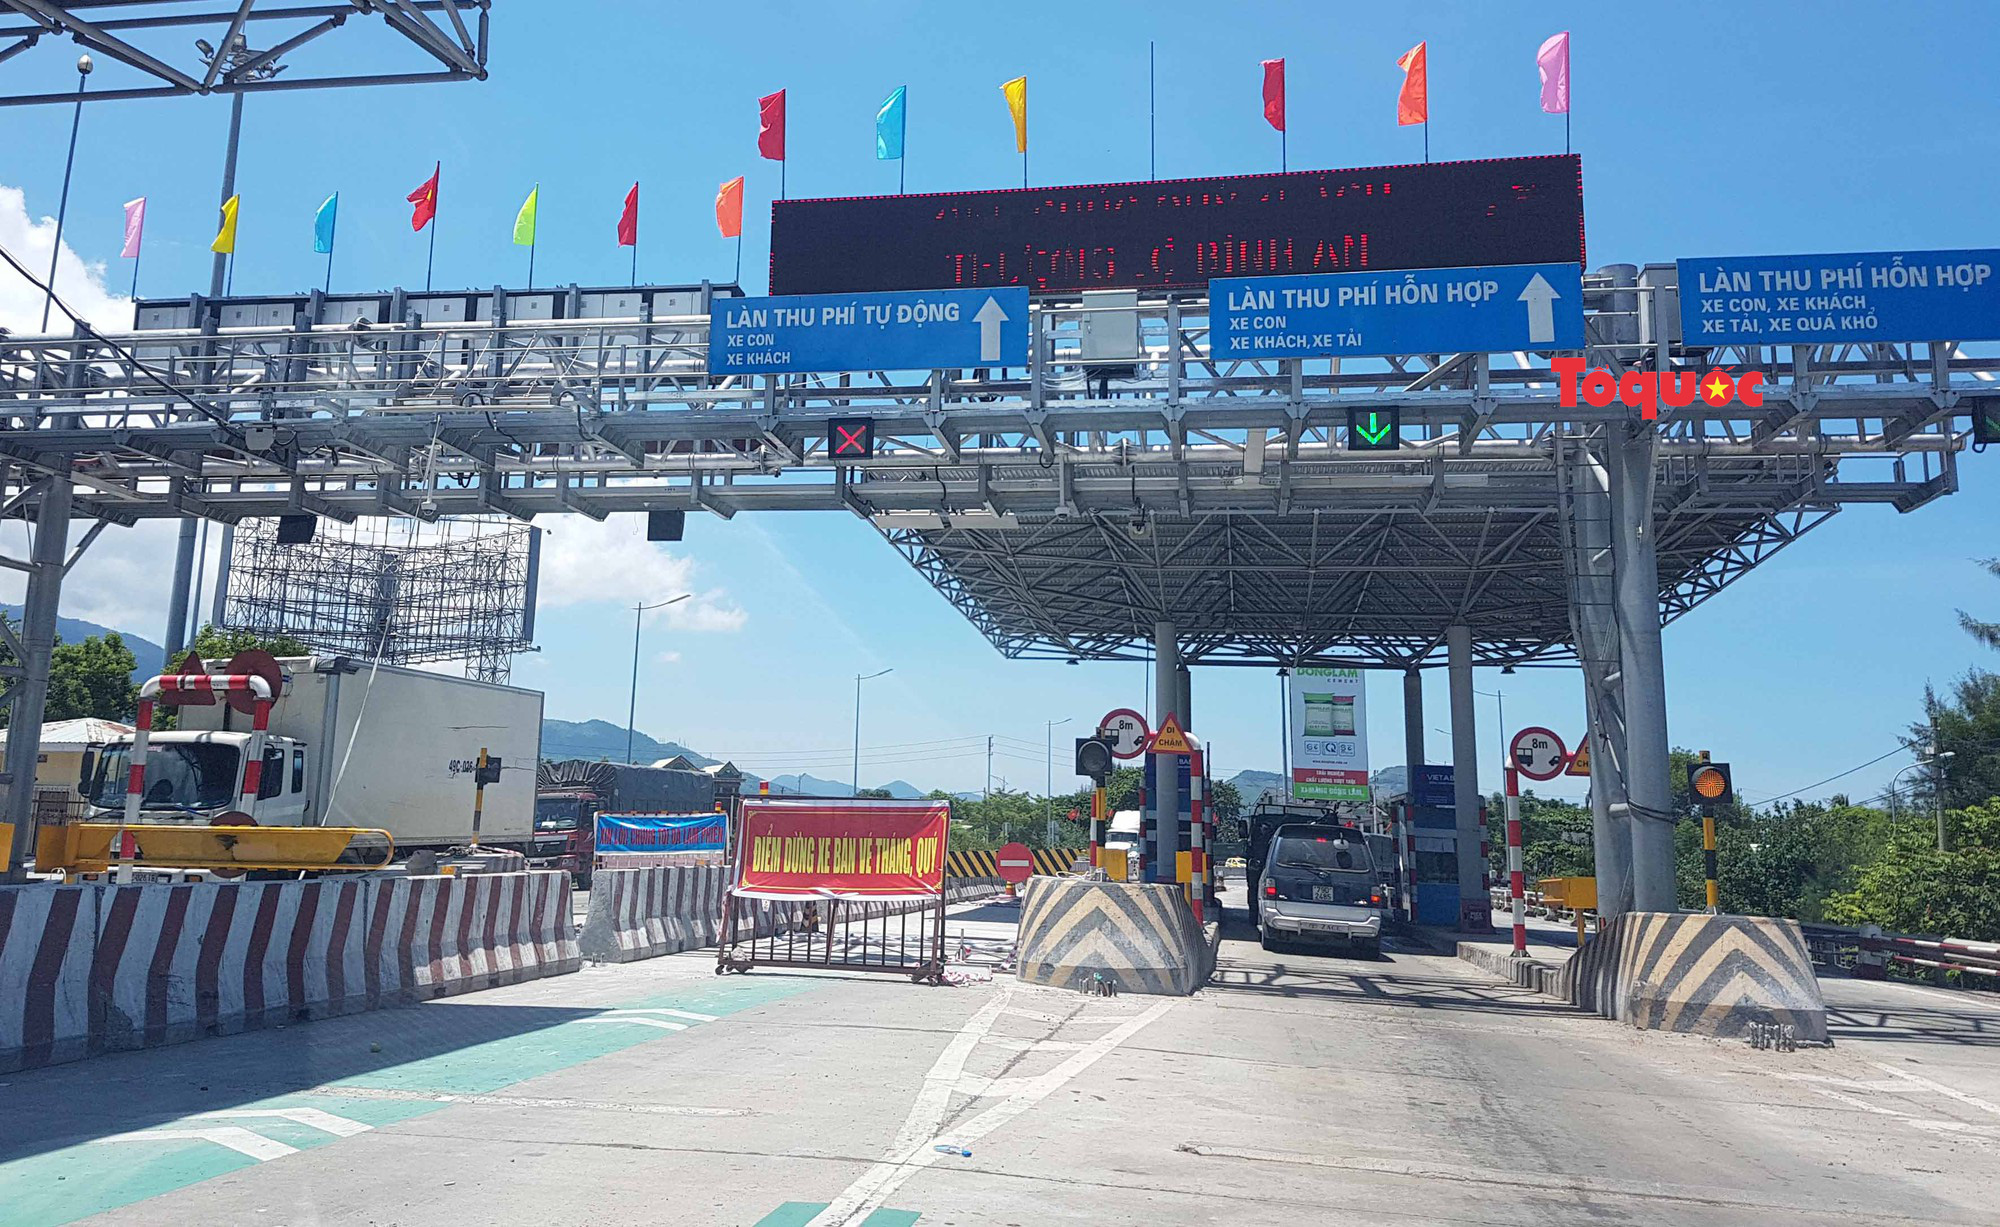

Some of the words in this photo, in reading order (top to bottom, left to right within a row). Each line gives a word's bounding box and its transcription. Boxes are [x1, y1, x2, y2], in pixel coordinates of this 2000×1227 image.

[1699, 266, 1750, 293] LÀN
[1759, 269, 1811, 292] THU
[1821, 262, 1863, 290] PHÍ
[1871, 256, 1928, 288] HỖN
[1937, 264, 1991, 292] HỢP
[1228, 286, 1275, 311] LÀN
[1282, 288, 1330, 309] THU
[1338, 280, 1378, 308] PHÍ
[1386, 274, 1438, 305] HỖN
[1447, 279, 1499, 308] HỢP
[1701, 299, 1724, 313] XE
[1729, 297, 1771, 313] CON,
[1777, 297, 1800, 312] XE
[1805, 292, 1866, 310] KHÁCH
[726, 304, 767, 329] LÀN
[774, 307, 815, 326] THU
[822, 301, 856, 325] PHÍ
[863, 304, 893, 330] TỰ
[897, 299, 960, 329] ĐỘNG
[1229, 317, 1249, 330] XE
[1253, 316, 1287, 330] CON
[1702, 319, 1725, 333] XE
[1732, 313, 1762, 334] TẢI,
[1768, 318, 1791, 332] XE
[1796, 312, 1836, 332] QUÁ
[1841, 306, 1878, 330] KHỔ
[727, 334, 743, 347] XE
[747, 333, 775, 347] CON
[1230, 336, 1250, 350] XE
[1337, 327, 1362, 347] TẢI
[726, 353, 743, 366] XE
[747, 347, 791, 365] KHÁCH
[1118, 720, 1134, 730] 8m
[1532, 738, 1548, 749] 8m
[1576, 759, 1590, 768] CH
[816, 836, 831, 874] XE
[833, 831, 855, 875] BÁN
[916, 830, 939, 878] QUÝ
